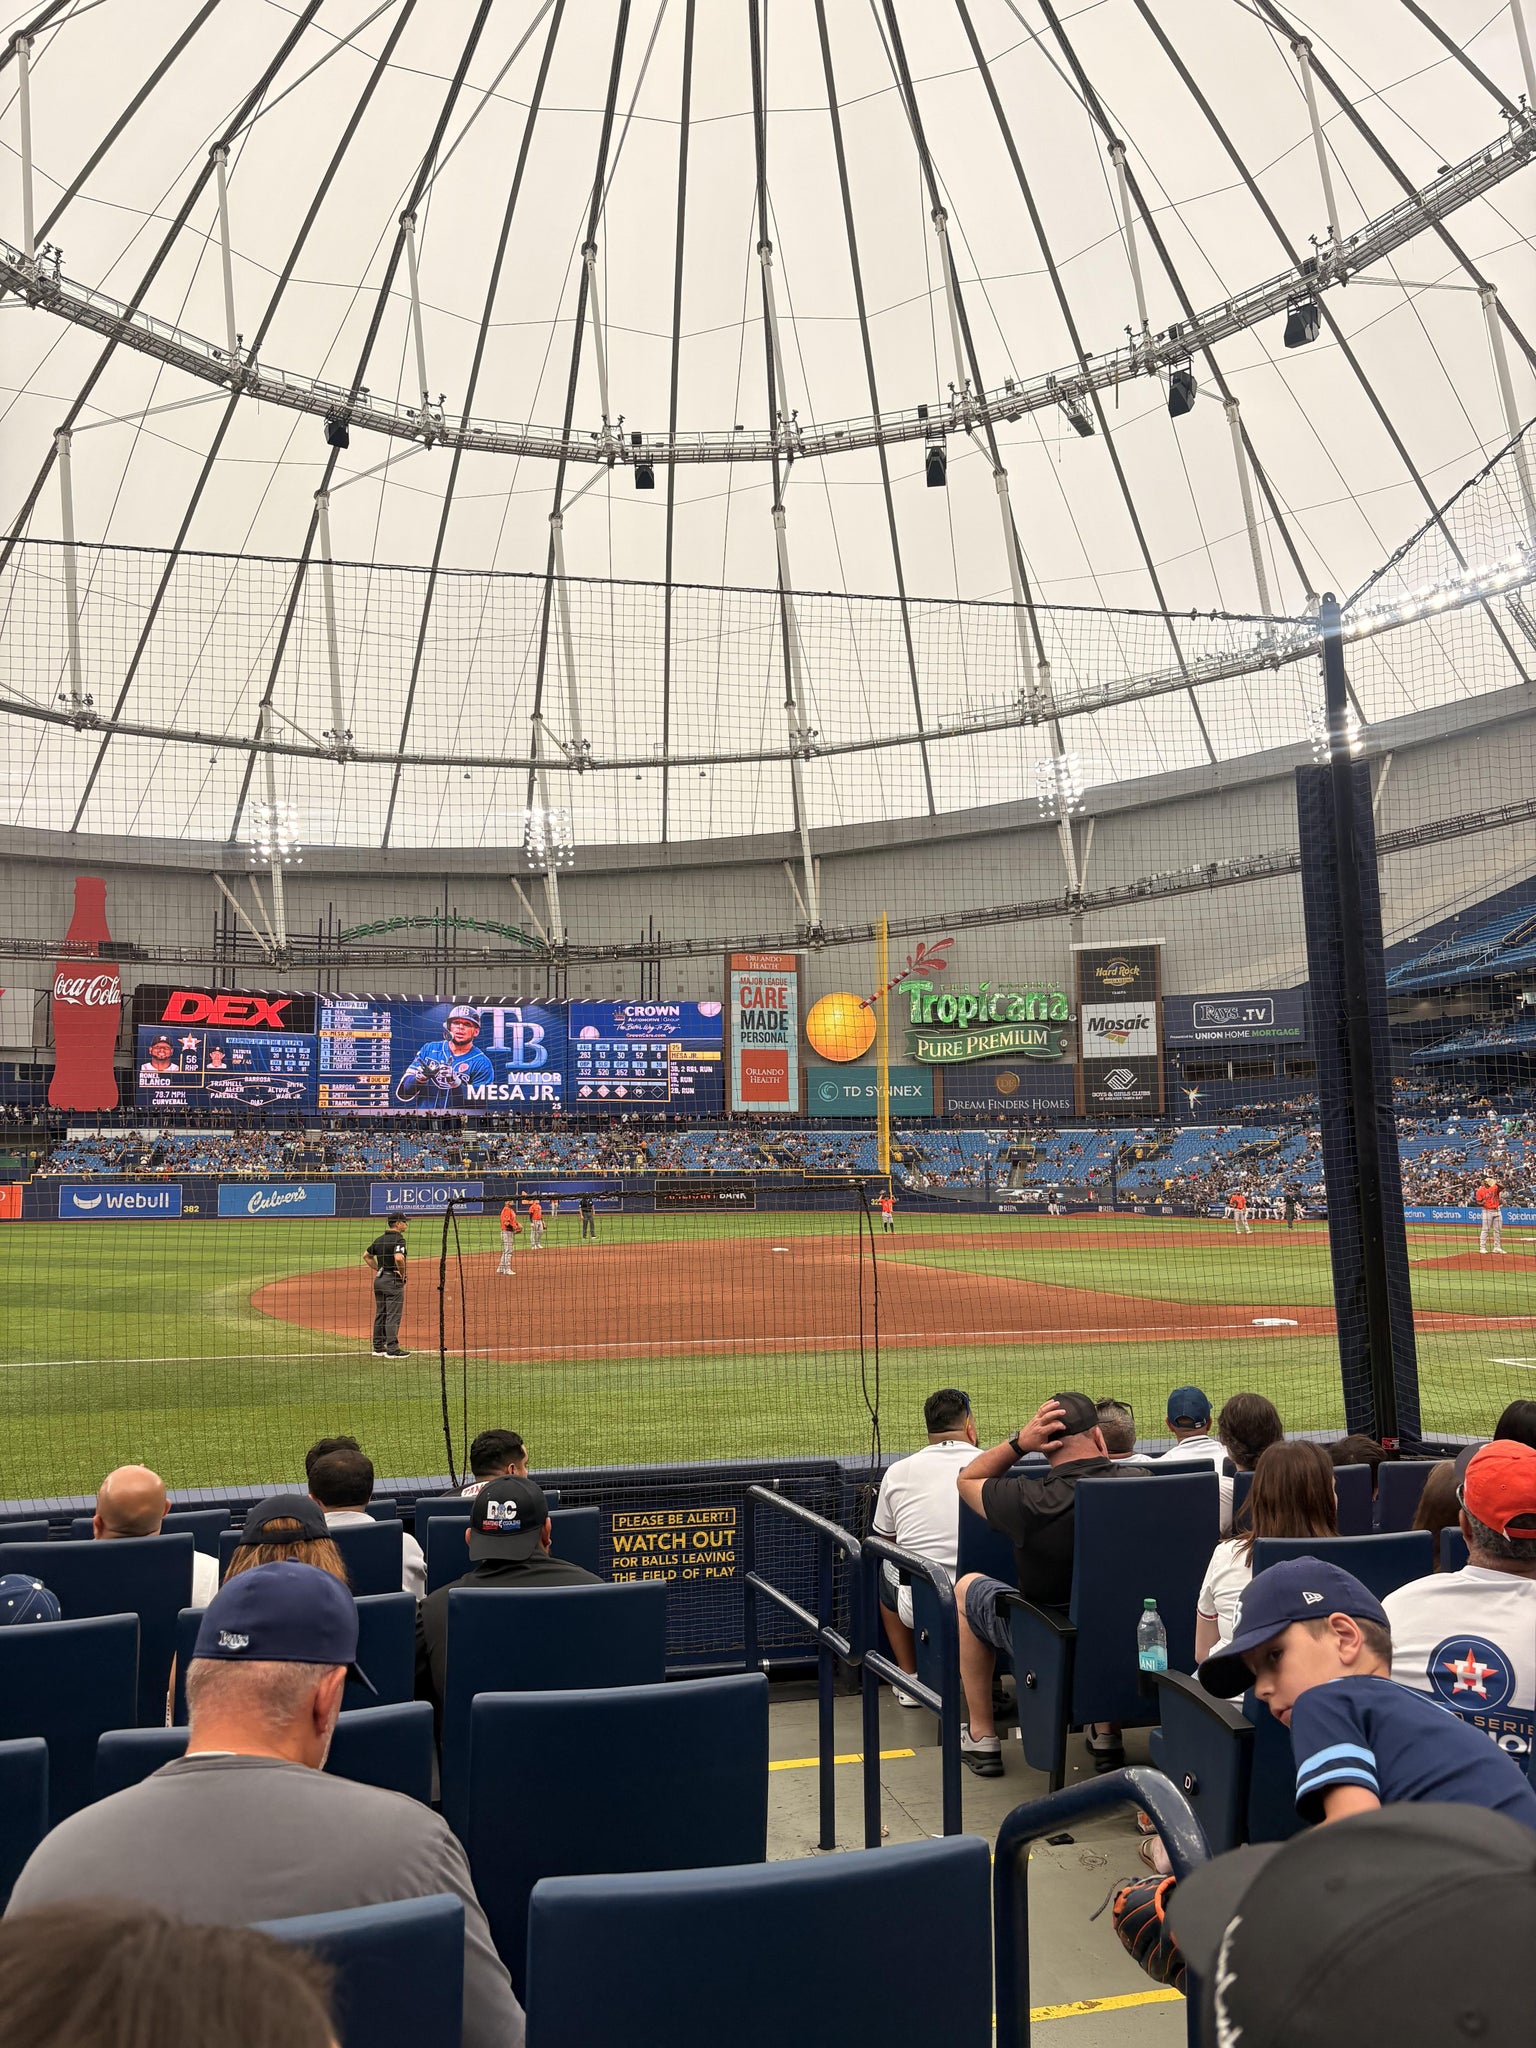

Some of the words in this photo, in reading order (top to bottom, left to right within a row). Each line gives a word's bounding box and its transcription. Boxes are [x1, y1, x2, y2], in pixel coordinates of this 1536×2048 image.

[340, 914, 478, 942] TROPICANA
[745, 954, 782, 962] ORLANDO
[749, 962, 779, 970] HEALTH
[1095, 966, 1118, 977] Hard
[1118, 965, 1140, 977] Rock
[740, 977, 763, 986] MAJOR
[764, 977, 788, 986] LEAGUE
[53, 972, 122, 1006] Coca-Cola
[739, 986, 789, 1009] CARE
[161, 991, 293, 1028] DEX
[625, 1005, 680, 1017] CROWN
[898, 980, 1069, 1029] Tropicana
[740, 1010, 789, 1031] MADE
[1200, 1004, 1239, 1024] RAYS
[1242, 1008, 1266, 1021] .TV
[1087, 1014, 1150, 1031] Mosaic
[476, 1006, 549, 1069] TB
[740, 1031, 789, 1044] PERSONAL
[1195, 1031, 1223, 1040] UNION
[1224, 1030, 1250, 1038] HOME
[1251, 1028, 1300, 1037] MORTGAGE
[917, 1039, 963, 1058] PURE
[966, 1029, 1048, 1054] PREMIUM
[185, 1055, 197, 1064] 56
[509, 1072, 562, 1083] VICTOR
[745, 1067, 784, 1076] ORLANDO
[139, 1078, 171, 1086] BLANCO
[749, 1075, 780, 1084] HEALTH
[154, 1091, 170, 1099] 78.7
[171, 1091, 186, 1099] MPH
[466, 1084, 525, 1101] MESA
[529, 1084, 560, 1101] JR.
[843, 1086, 861, 1097] TD
[552, 1102, 562, 1110] 25
[948, 1099, 986, 1111] DREAM
[988, 1099, 1030, 1111] FINDERS
[1032, 1098, 1070, 1110] HOMES
[107, 1192, 170, 1209] Webull
[248, 1186, 307, 1214] Culver's
[183, 1205, 200, 1213] 382
[1432, 1209, 1457, 1219] Spectrum
[618, 1515, 664, 1528] PLEASE
[668, 1514, 683, 1525] BE
[686, 1511, 729, 1524] ALERT!
[612, 1532, 687, 1553] WATCH
[692, 1530, 736, 1549] OUT
[612, 1557, 638, 1568] FOR
[641, 1554, 678, 1567] BALLS
[682, 1551, 735, 1564] LEAVING
[612, 1572, 636, 1584] THE
[642, 1570, 677, 1582] FIELD
[682, 1568, 700, 1579] OF
[705, 1566, 735, 1578] PLAY
